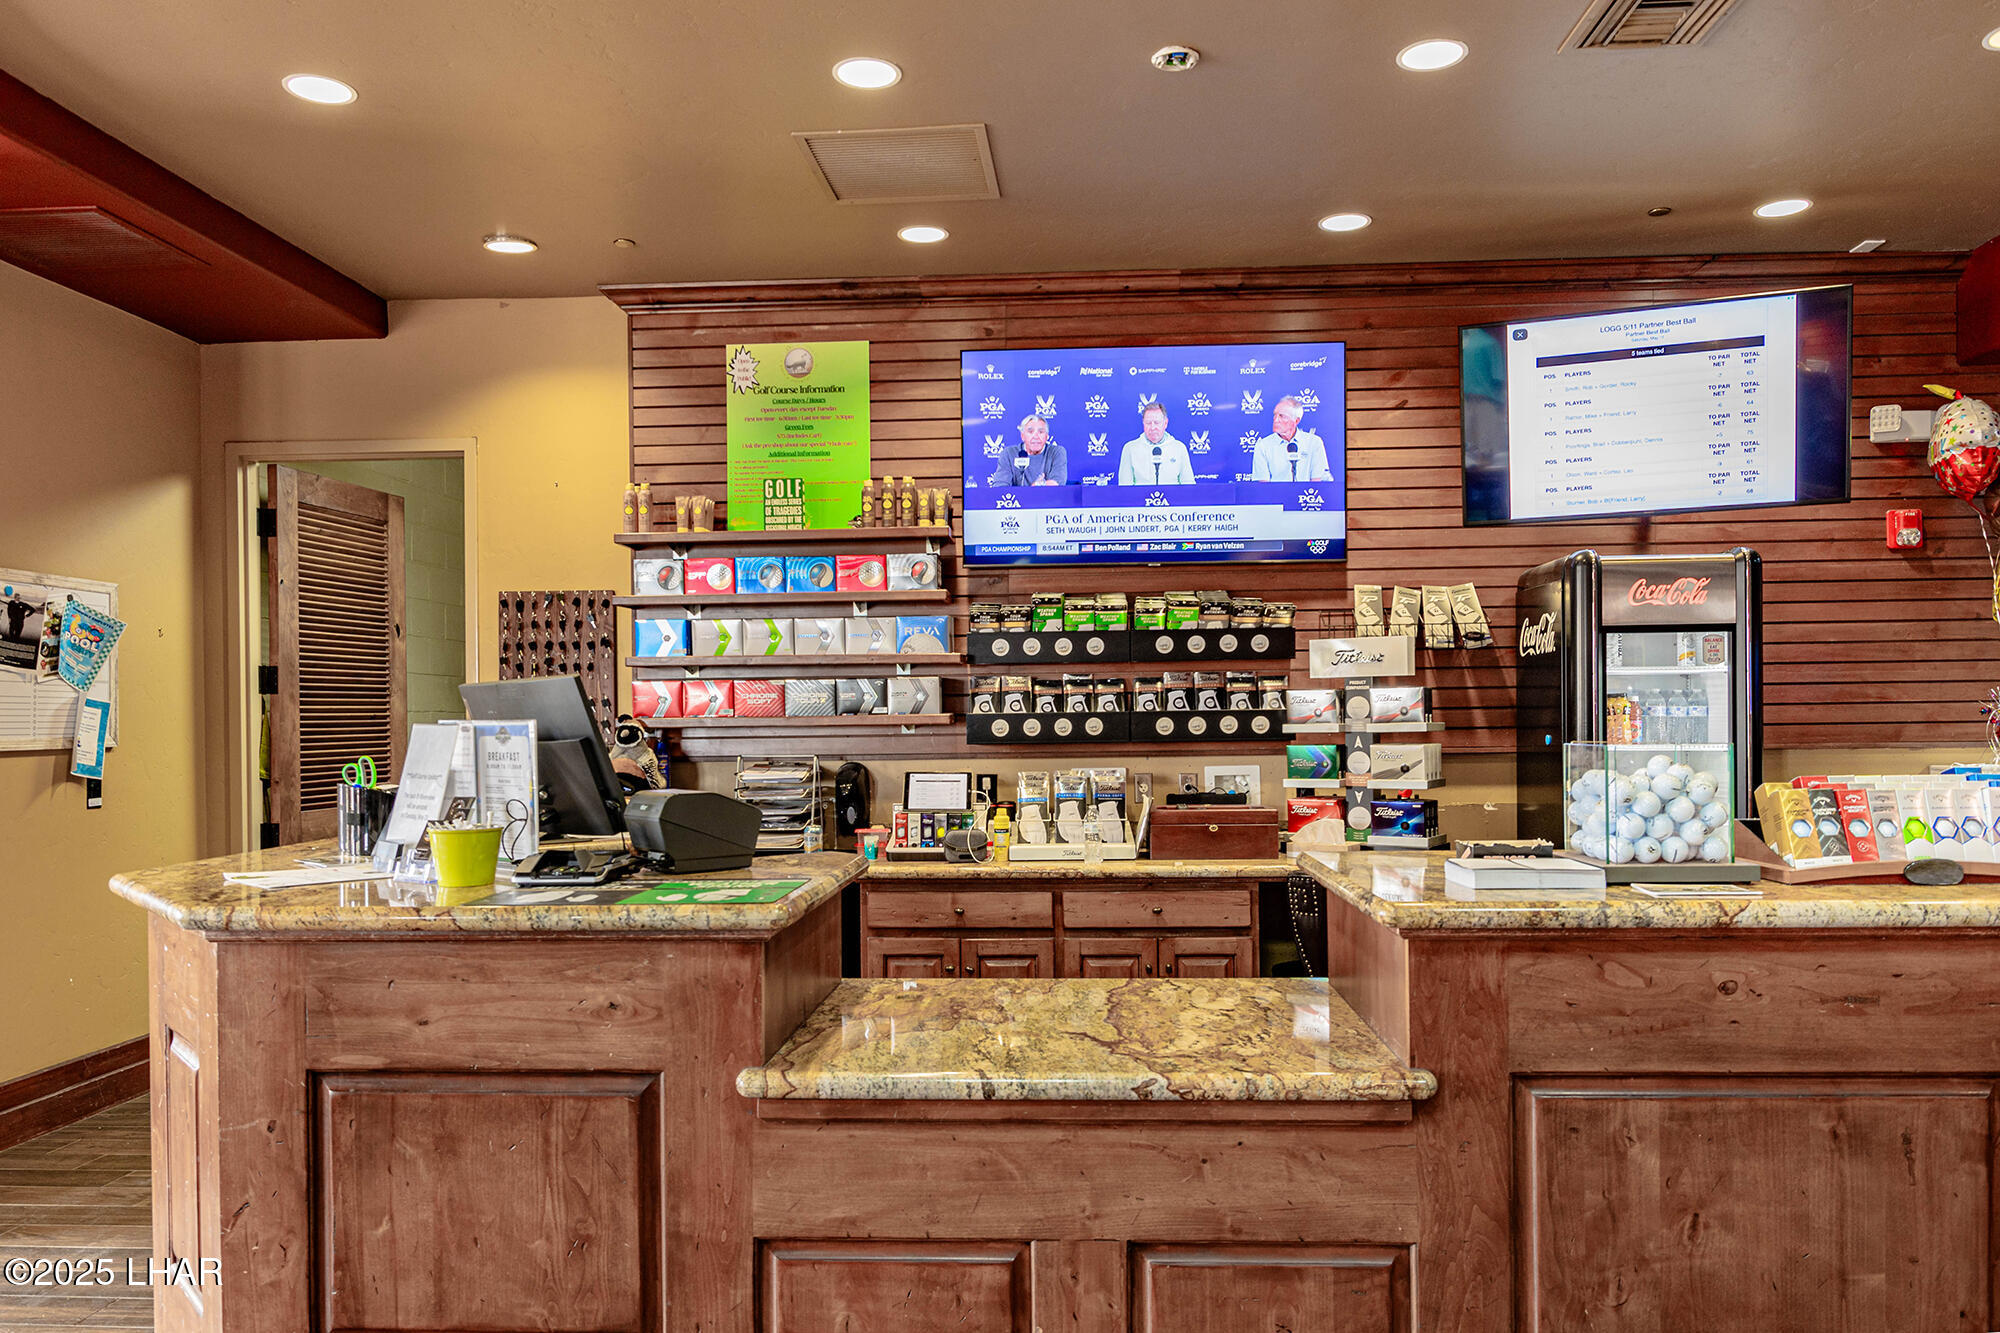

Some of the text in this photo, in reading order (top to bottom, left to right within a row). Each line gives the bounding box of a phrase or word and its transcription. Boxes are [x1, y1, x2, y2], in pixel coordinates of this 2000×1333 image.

[1600, 325, 1621, 333] LOGG
[1640, 321, 1664, 329] Partner
[1087, 367, 1113, 375] National
[1564, 370, 1592, 378] PLAYERS
[754, 385, 845, 395] Golf Course Information
[980, 403, 1006, 411] PGA
[1085, 402, 1109, 410] PGA
[1188, 399, 1212, 407] PGA
[1241, 402, 1263, 411] PGA
[1036, 407, 1057, 415] PGA
[1088, 445, 1108, 453] PGA
[1190, 443, 1210, 451] PGA
[765, 480, 801, 498] GOLF
[1145, 498, 1170, 506] PGA
[1298, 495, 1324, 503] PGA
[996, 500, 1021, 508] PGA
[765, 506, 802, 516] OF TRAGEDIES
[1045, 512, 1235, 524] PGA of America Press Conference
[1068, 526, 1096, 534] WAUGH
[1129, 525, 1162, 534] LINDERT,
[1221, 542, 1244, 550] Velzen
[1627, 577, 1711, 607] Coca-Cola
[904, 626, 940, 636] REVA
[65, 631, 99, 652] POOL
[488, 752, 520, 761] BREAKFAST
[1290, 759, 1318, 768] Titleist
[1291, 805, 1318, 814] Titleist
[1374, 807, 1404, 817] Titleist
